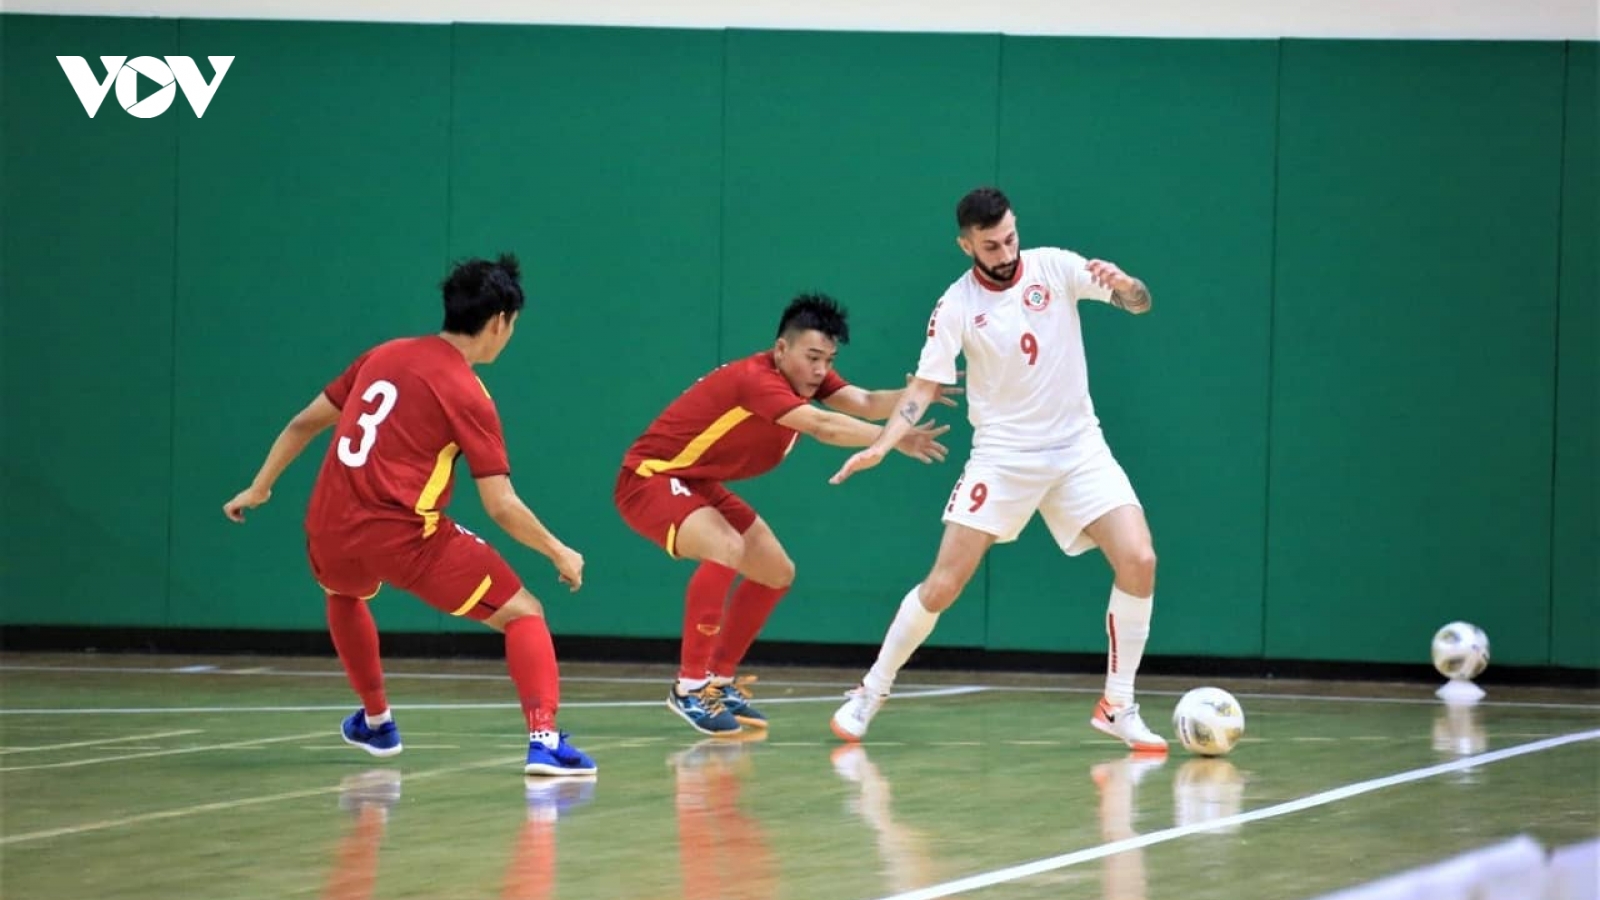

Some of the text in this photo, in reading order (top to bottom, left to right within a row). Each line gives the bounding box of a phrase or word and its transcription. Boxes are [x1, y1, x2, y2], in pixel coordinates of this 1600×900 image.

[1020, 333, 1038, 366] 9
[337, 380, 398, 467] 3
[670, 477, 692, 497] 4
[969, 482, 988, 513] 9
